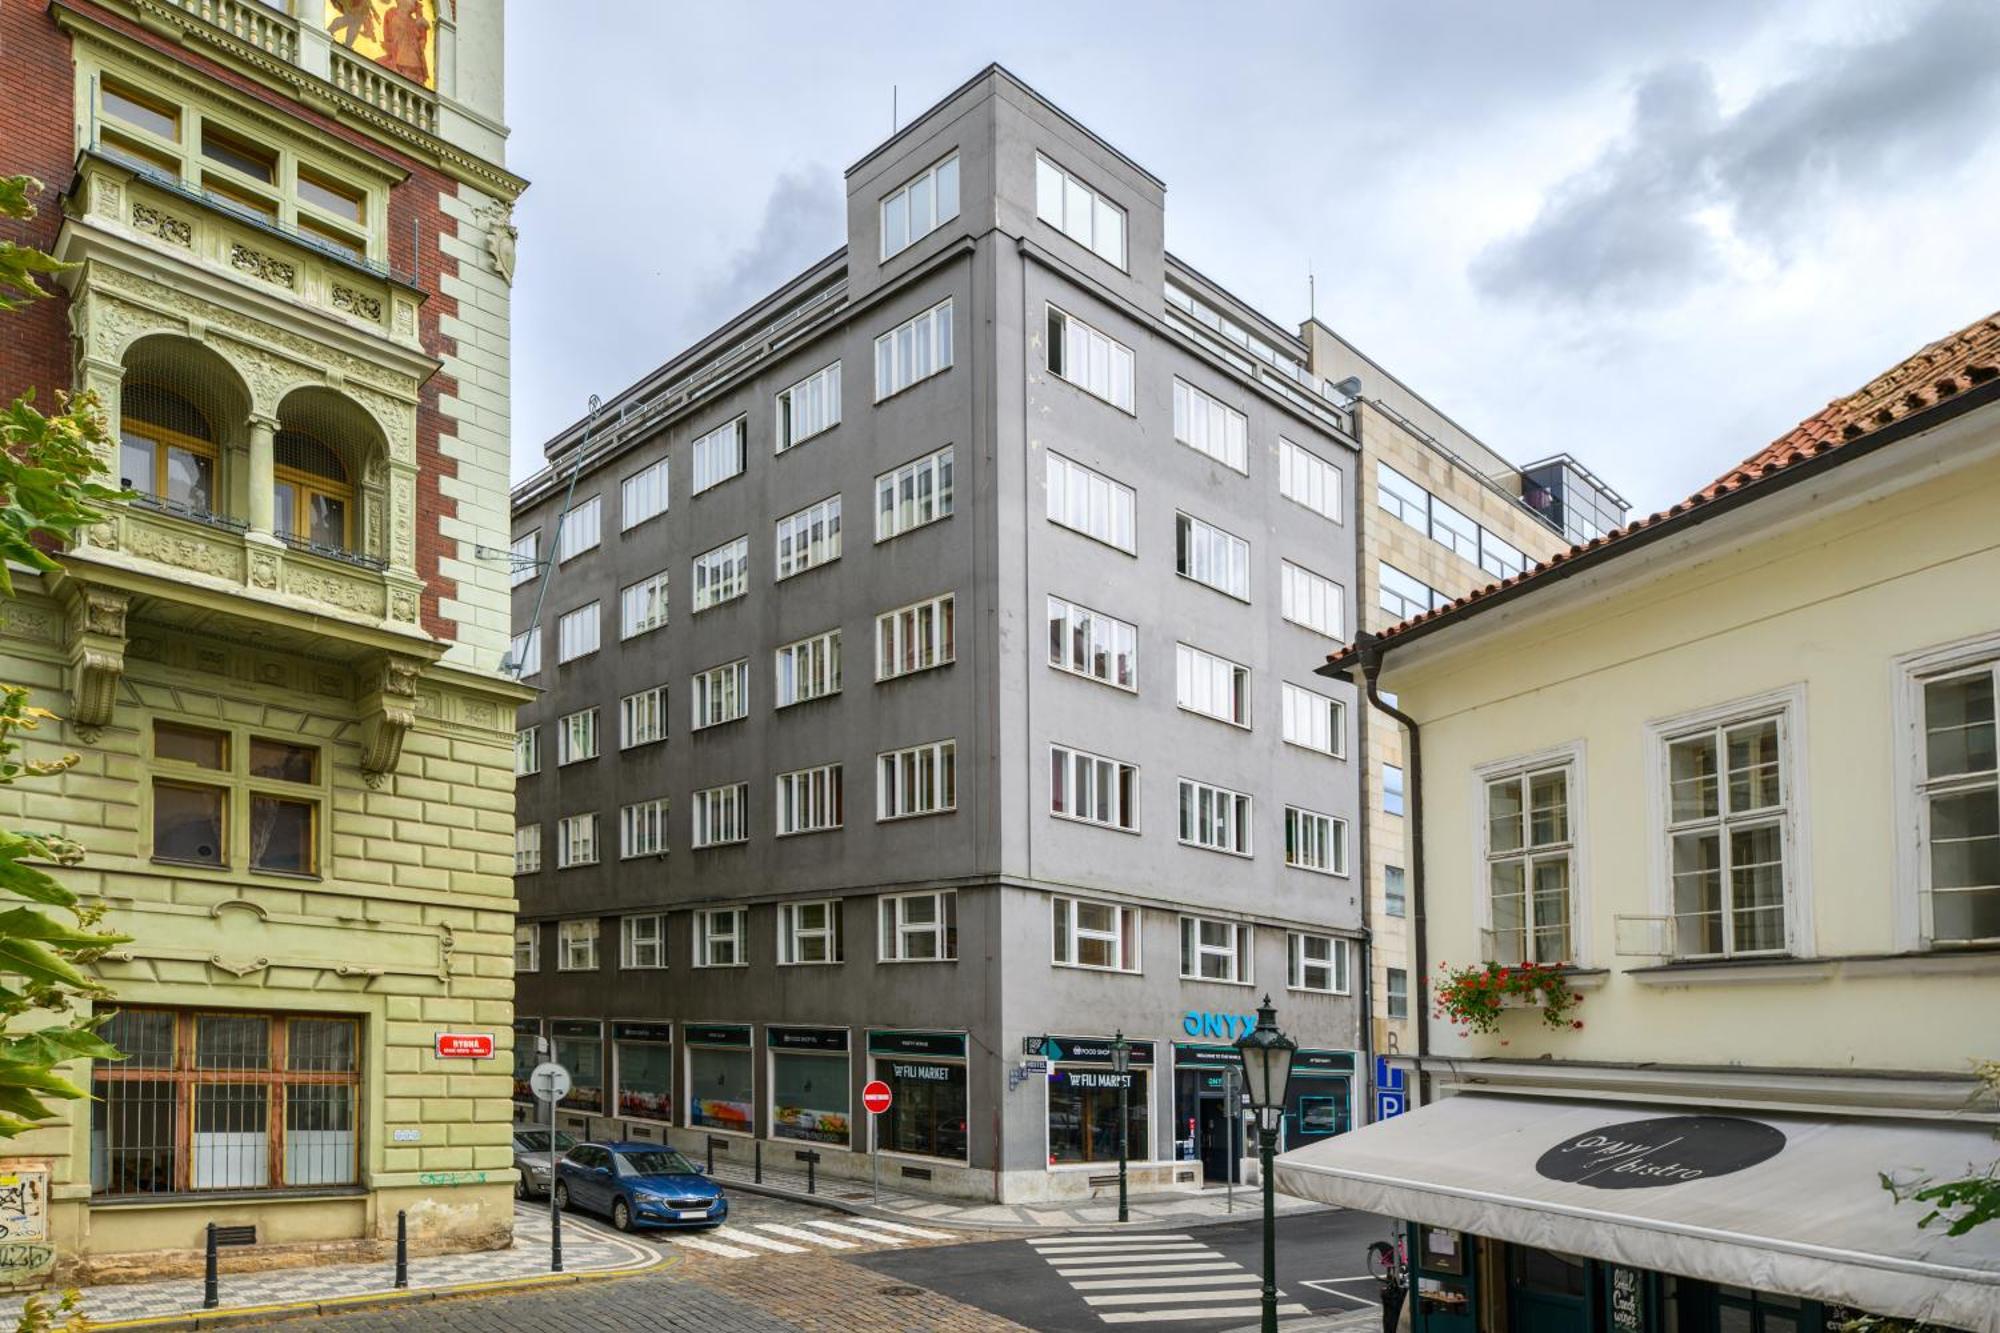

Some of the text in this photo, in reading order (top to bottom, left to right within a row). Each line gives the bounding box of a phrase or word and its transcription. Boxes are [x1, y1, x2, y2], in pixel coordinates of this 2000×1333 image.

[1184, 1010, 1257, 1040] ONYX
[903, 1065, 949, 1081] FILI MARKET
[1081, 1073, 1097, 1087] FILI
[1382, 1096, 1399, 1120] P
